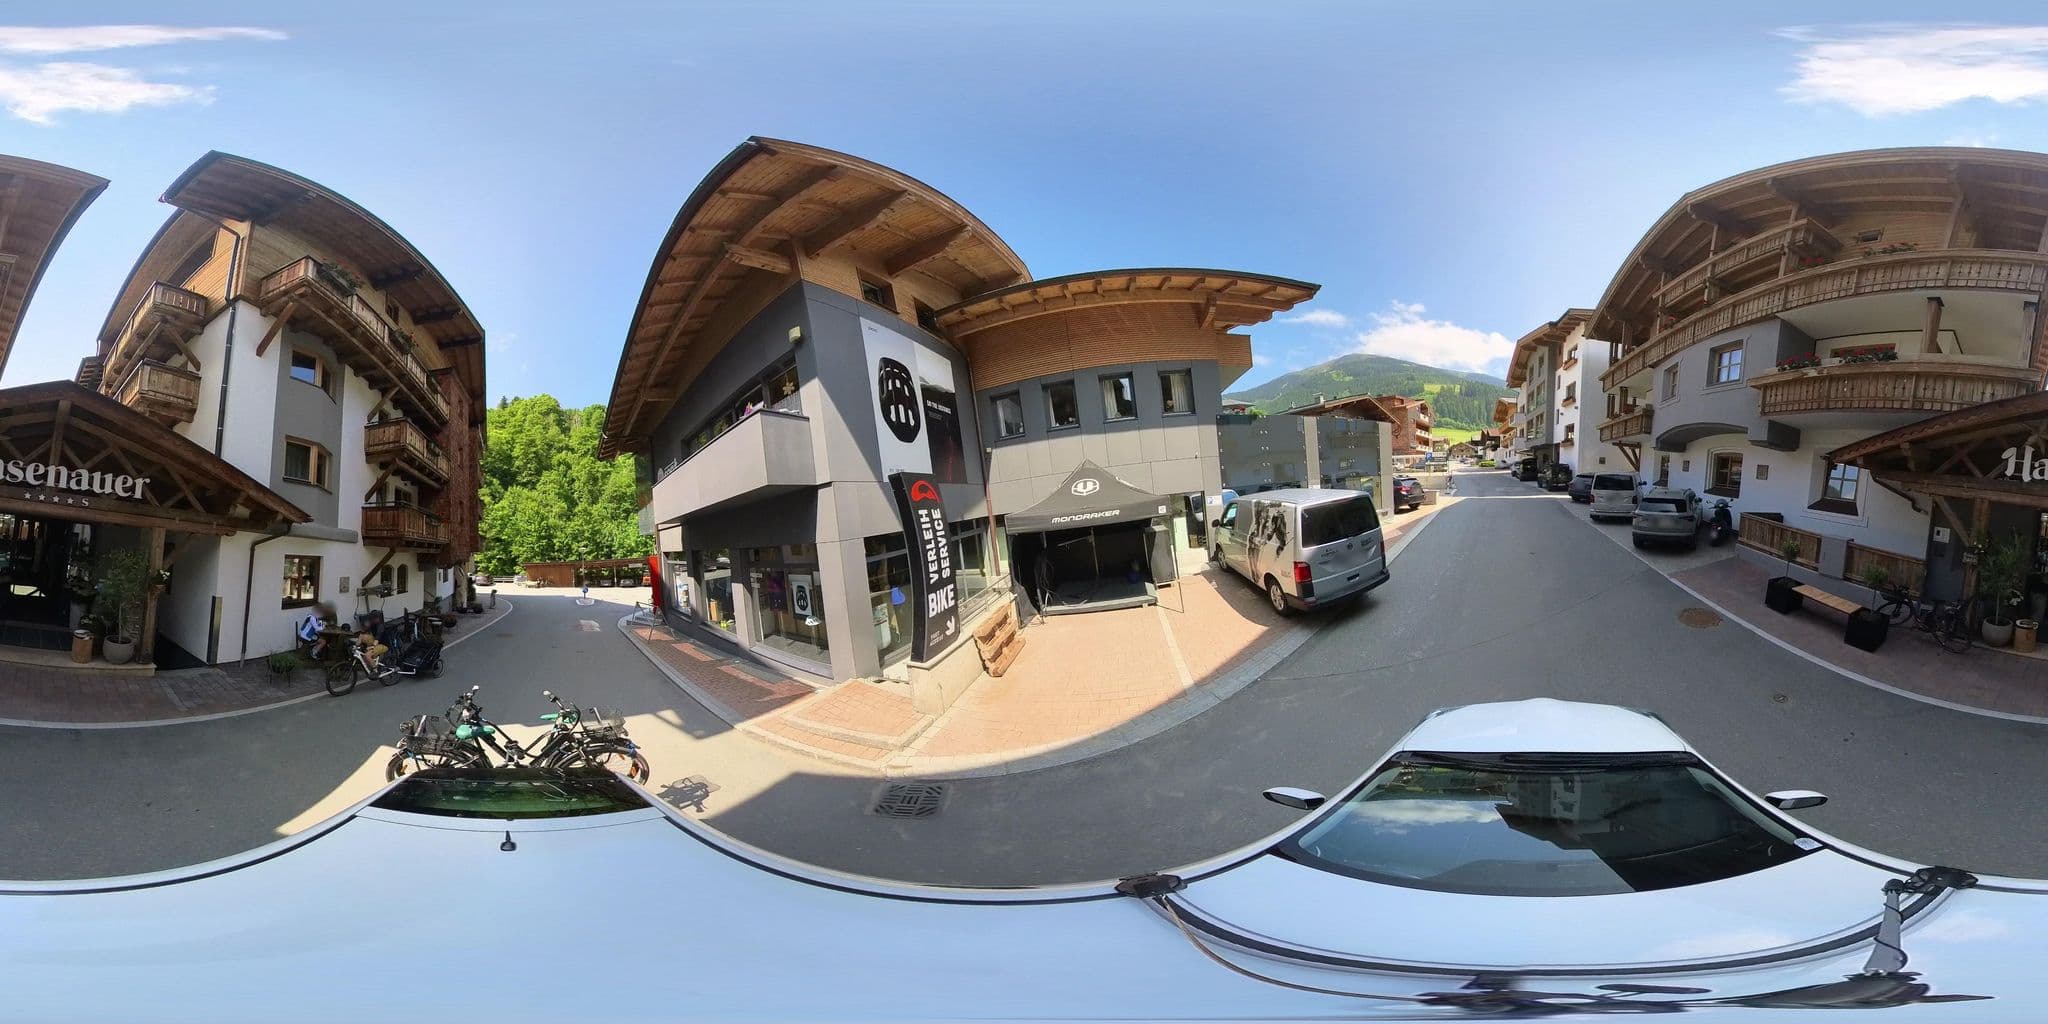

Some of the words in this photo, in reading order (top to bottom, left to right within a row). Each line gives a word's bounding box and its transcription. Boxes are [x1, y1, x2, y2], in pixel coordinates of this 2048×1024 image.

[0, 459, 150, 499] senauer
[1052, 510, 1120, 524] MONDRAKER
[918, 509, 939, 584] VERLEIH
[932, 508, 950, 579] SERVICE
[928, 584, 955, 618] BIKE
